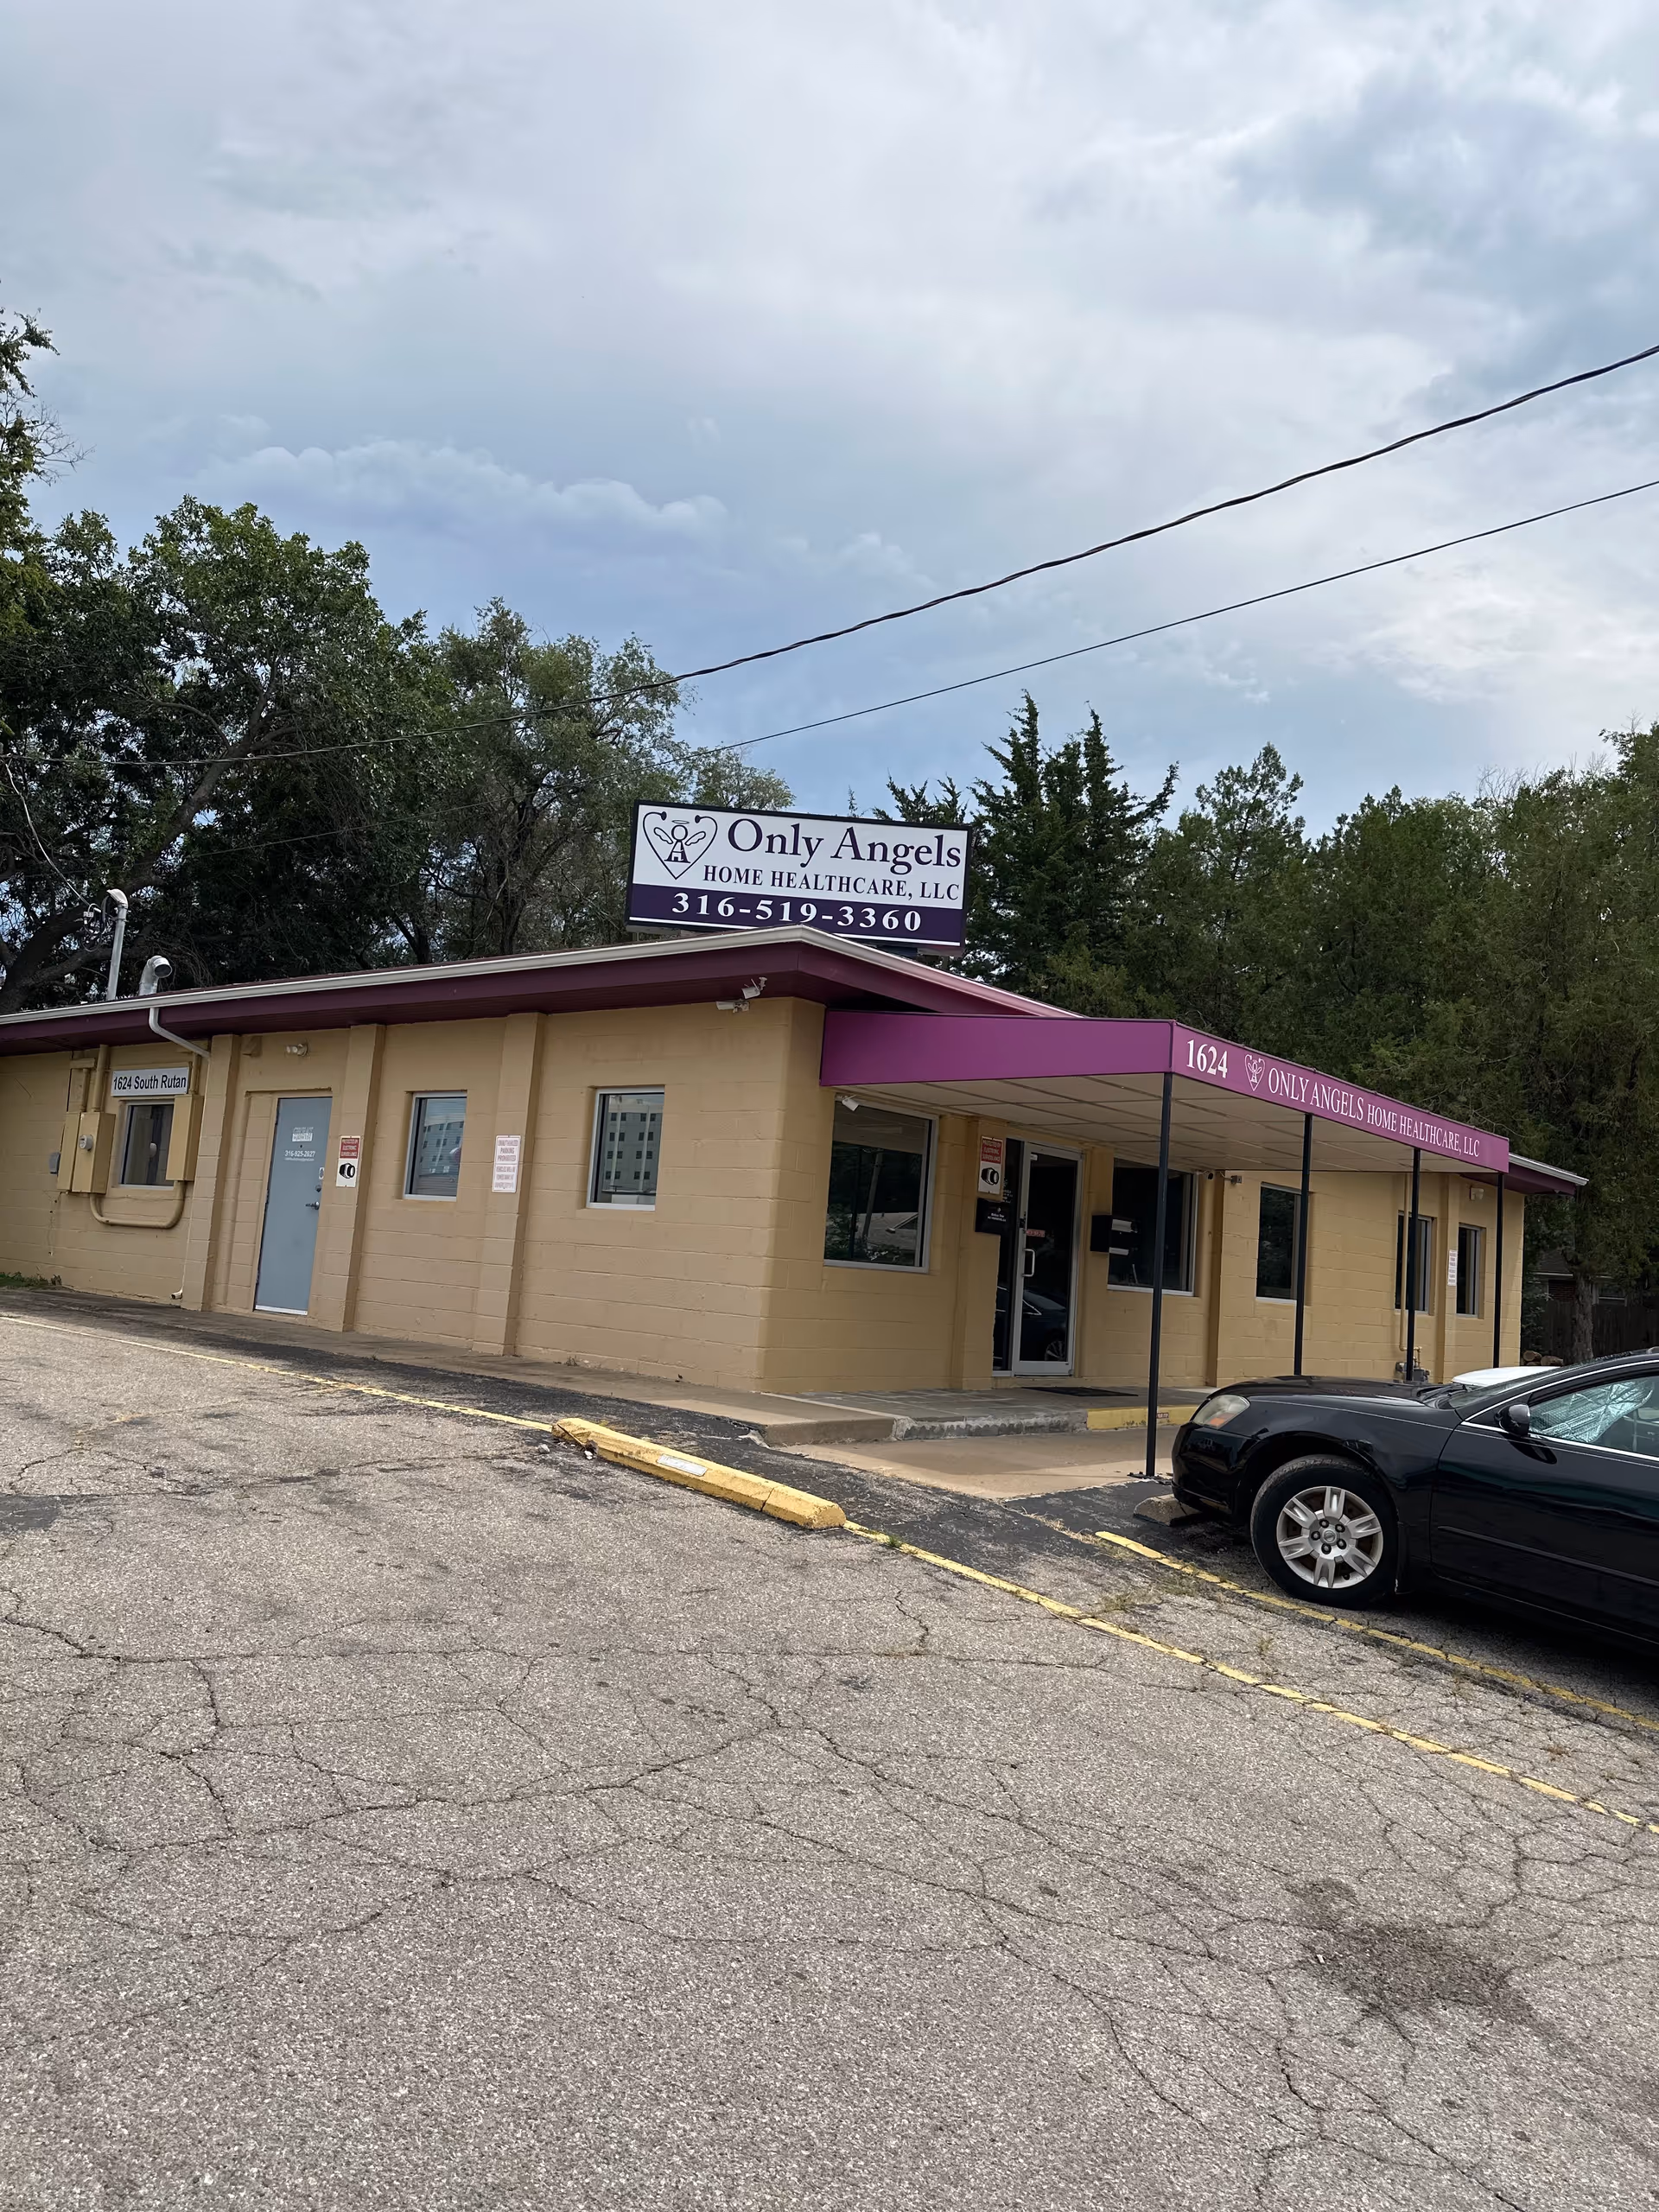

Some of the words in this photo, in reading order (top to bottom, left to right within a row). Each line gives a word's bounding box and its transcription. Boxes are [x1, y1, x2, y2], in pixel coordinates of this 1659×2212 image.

[728, 818, 824, 868] Only
[830, 826, 961, 875] Angels
[702, 865, 763, 887] HOME
[770, 870, 913, 900] HEALTHCARE,
[919, 881, 960, 901] LLC
[671, 892, 922, 931] 316-519-3360
[113, 1076, 132, 1090] 1624
[134, 1075, 159, 1090] South
[161, 1074, 187, 1089] Rutan
[1186, 1039, 1228, 1079] 1624
[1268, 1067, 1309, 1103] ONLY
[1310, 1085, 1364, 1122] ANGELS
[1367, 1103, 1397, 1132] HOME
[1399, 1115, 1462, 1156] HEALTHCARE,
[1463, 1135, 1480, 1158] LLC
